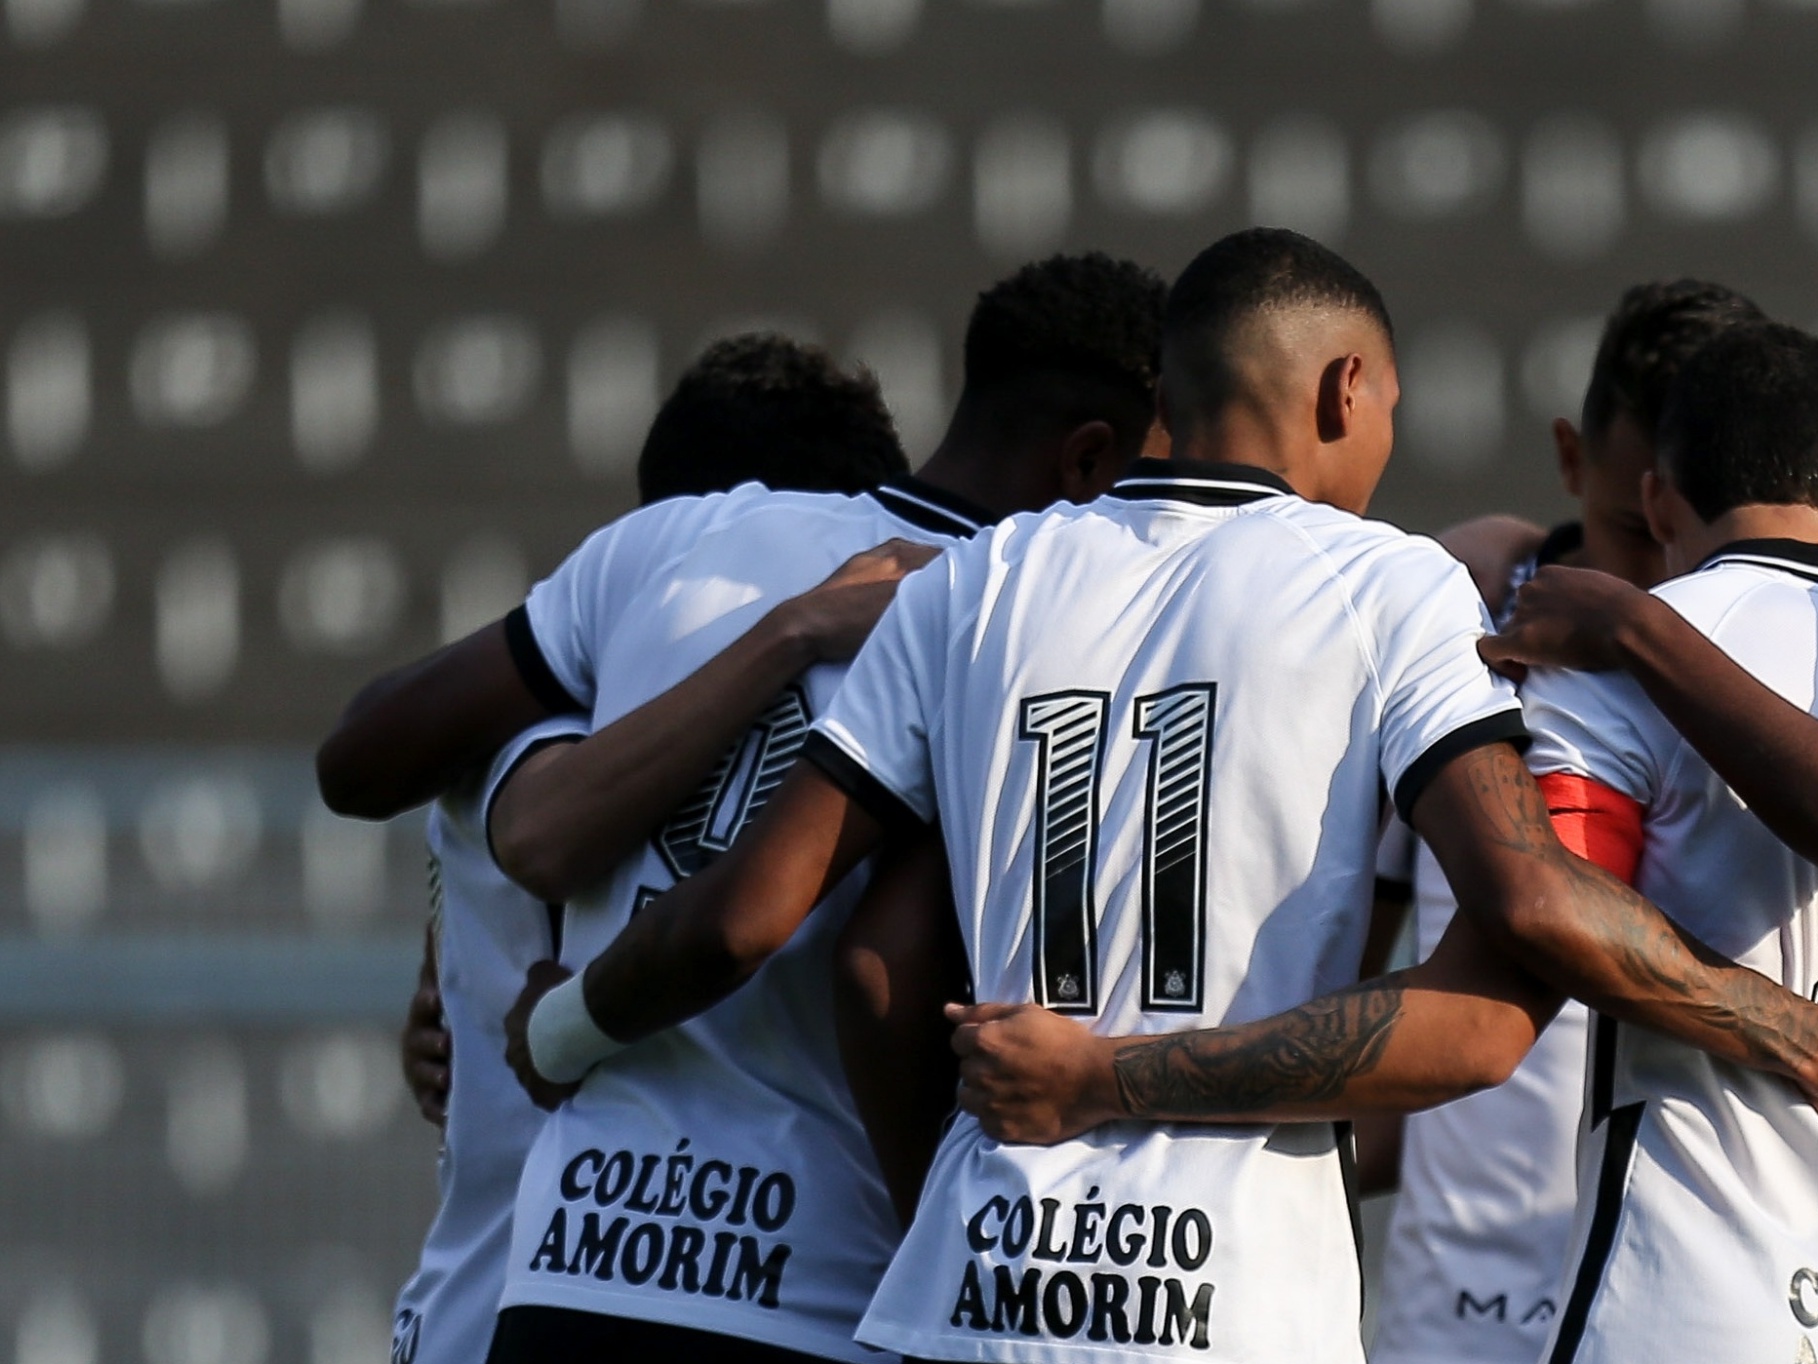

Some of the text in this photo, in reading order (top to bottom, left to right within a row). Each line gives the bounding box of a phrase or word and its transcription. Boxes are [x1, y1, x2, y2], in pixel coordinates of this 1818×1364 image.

[1019, 681, 1217, 1015] 11
[559, 1138, 796, 1233] COLÉGIO
[967, 1186, 1212, 1272] COLÉGIO
[530, 1207, 792, 1310] AMORIM
[950, 1260, 1215, 1351] AMORIM
